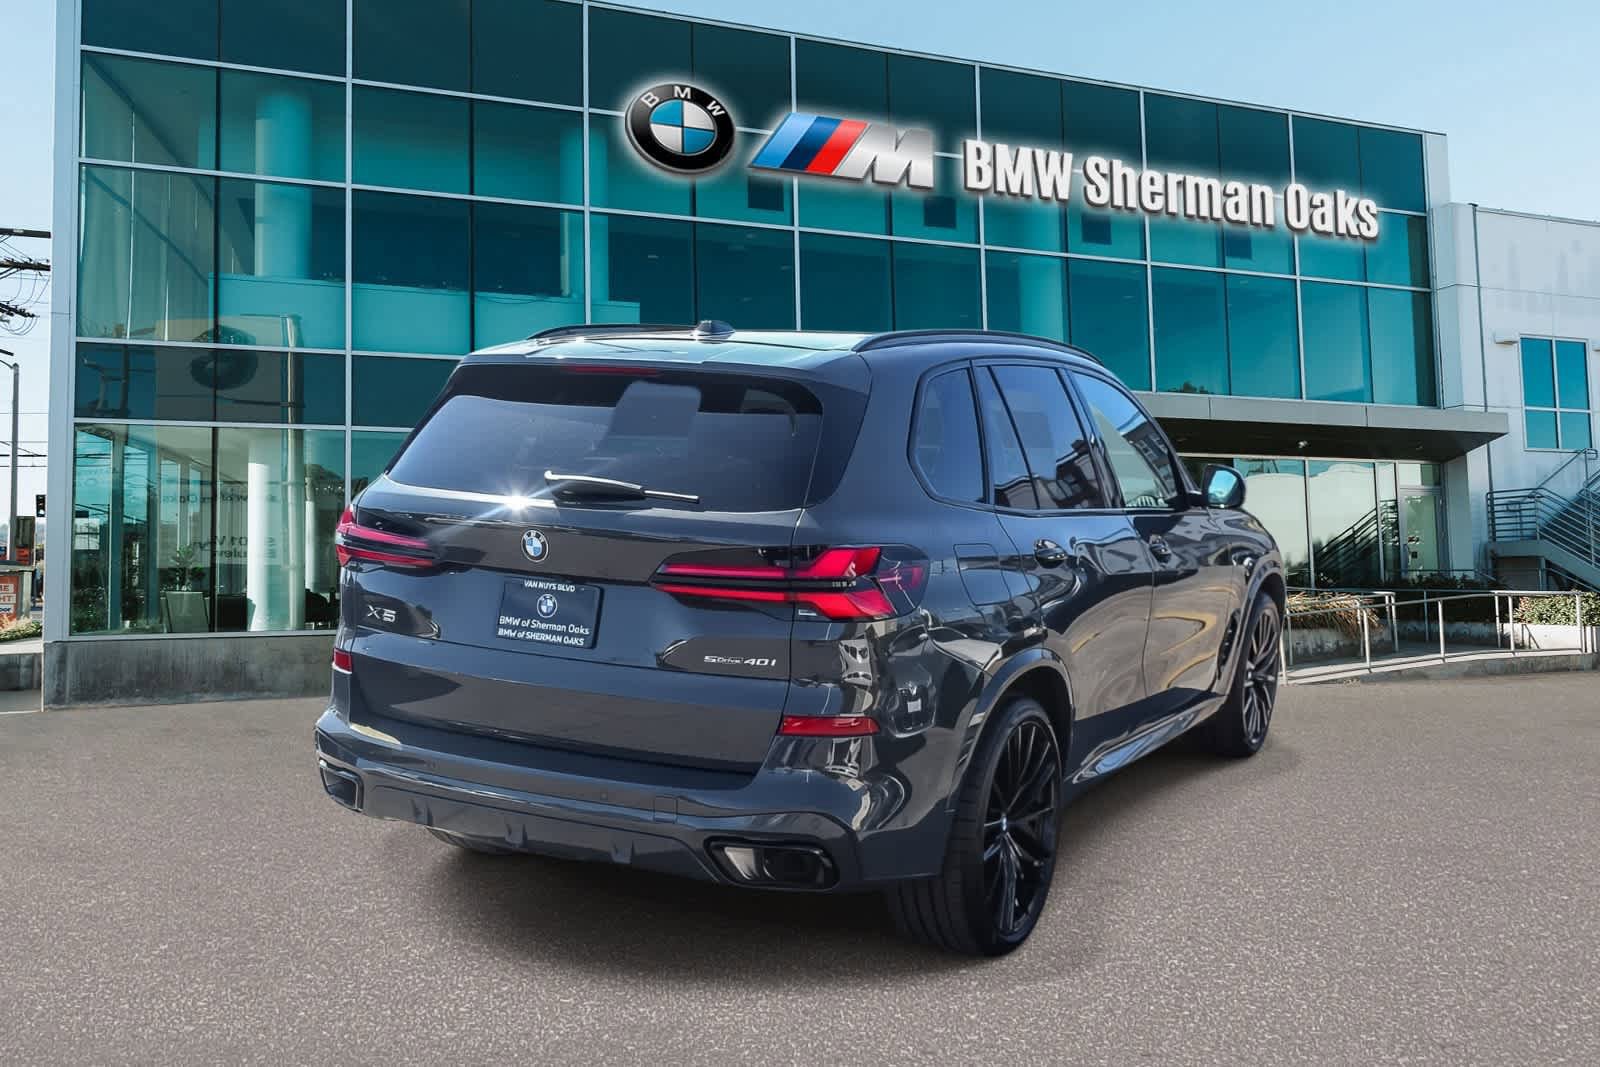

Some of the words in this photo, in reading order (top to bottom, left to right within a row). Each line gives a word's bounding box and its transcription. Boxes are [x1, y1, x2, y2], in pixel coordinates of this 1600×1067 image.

[641, 85, 725, 117] BMW
[963, 139, 1073, 202] BMW
[1083, 155, 1275, 228] Sherman
[1284, 182, 1379, 241] Oaks
[524, 580, 538, 589] VAN
[538, 581, 556, 591] NUYS
[557, 583, 576, 593] BLVD
[367, 604, 397, 622] X5
[499, 615, 520, 626] BMW
[521, 618, 530, 627] of
[530, 619, 567, 633] Sherman
[568, 623, 590, 635] Oaks
[498, 627, 517, 638] BMW
[517, 630, 526, 638] of
[525, 631, 562, 643] SHERMAN
[563, 635, 585, 646] OAKS
